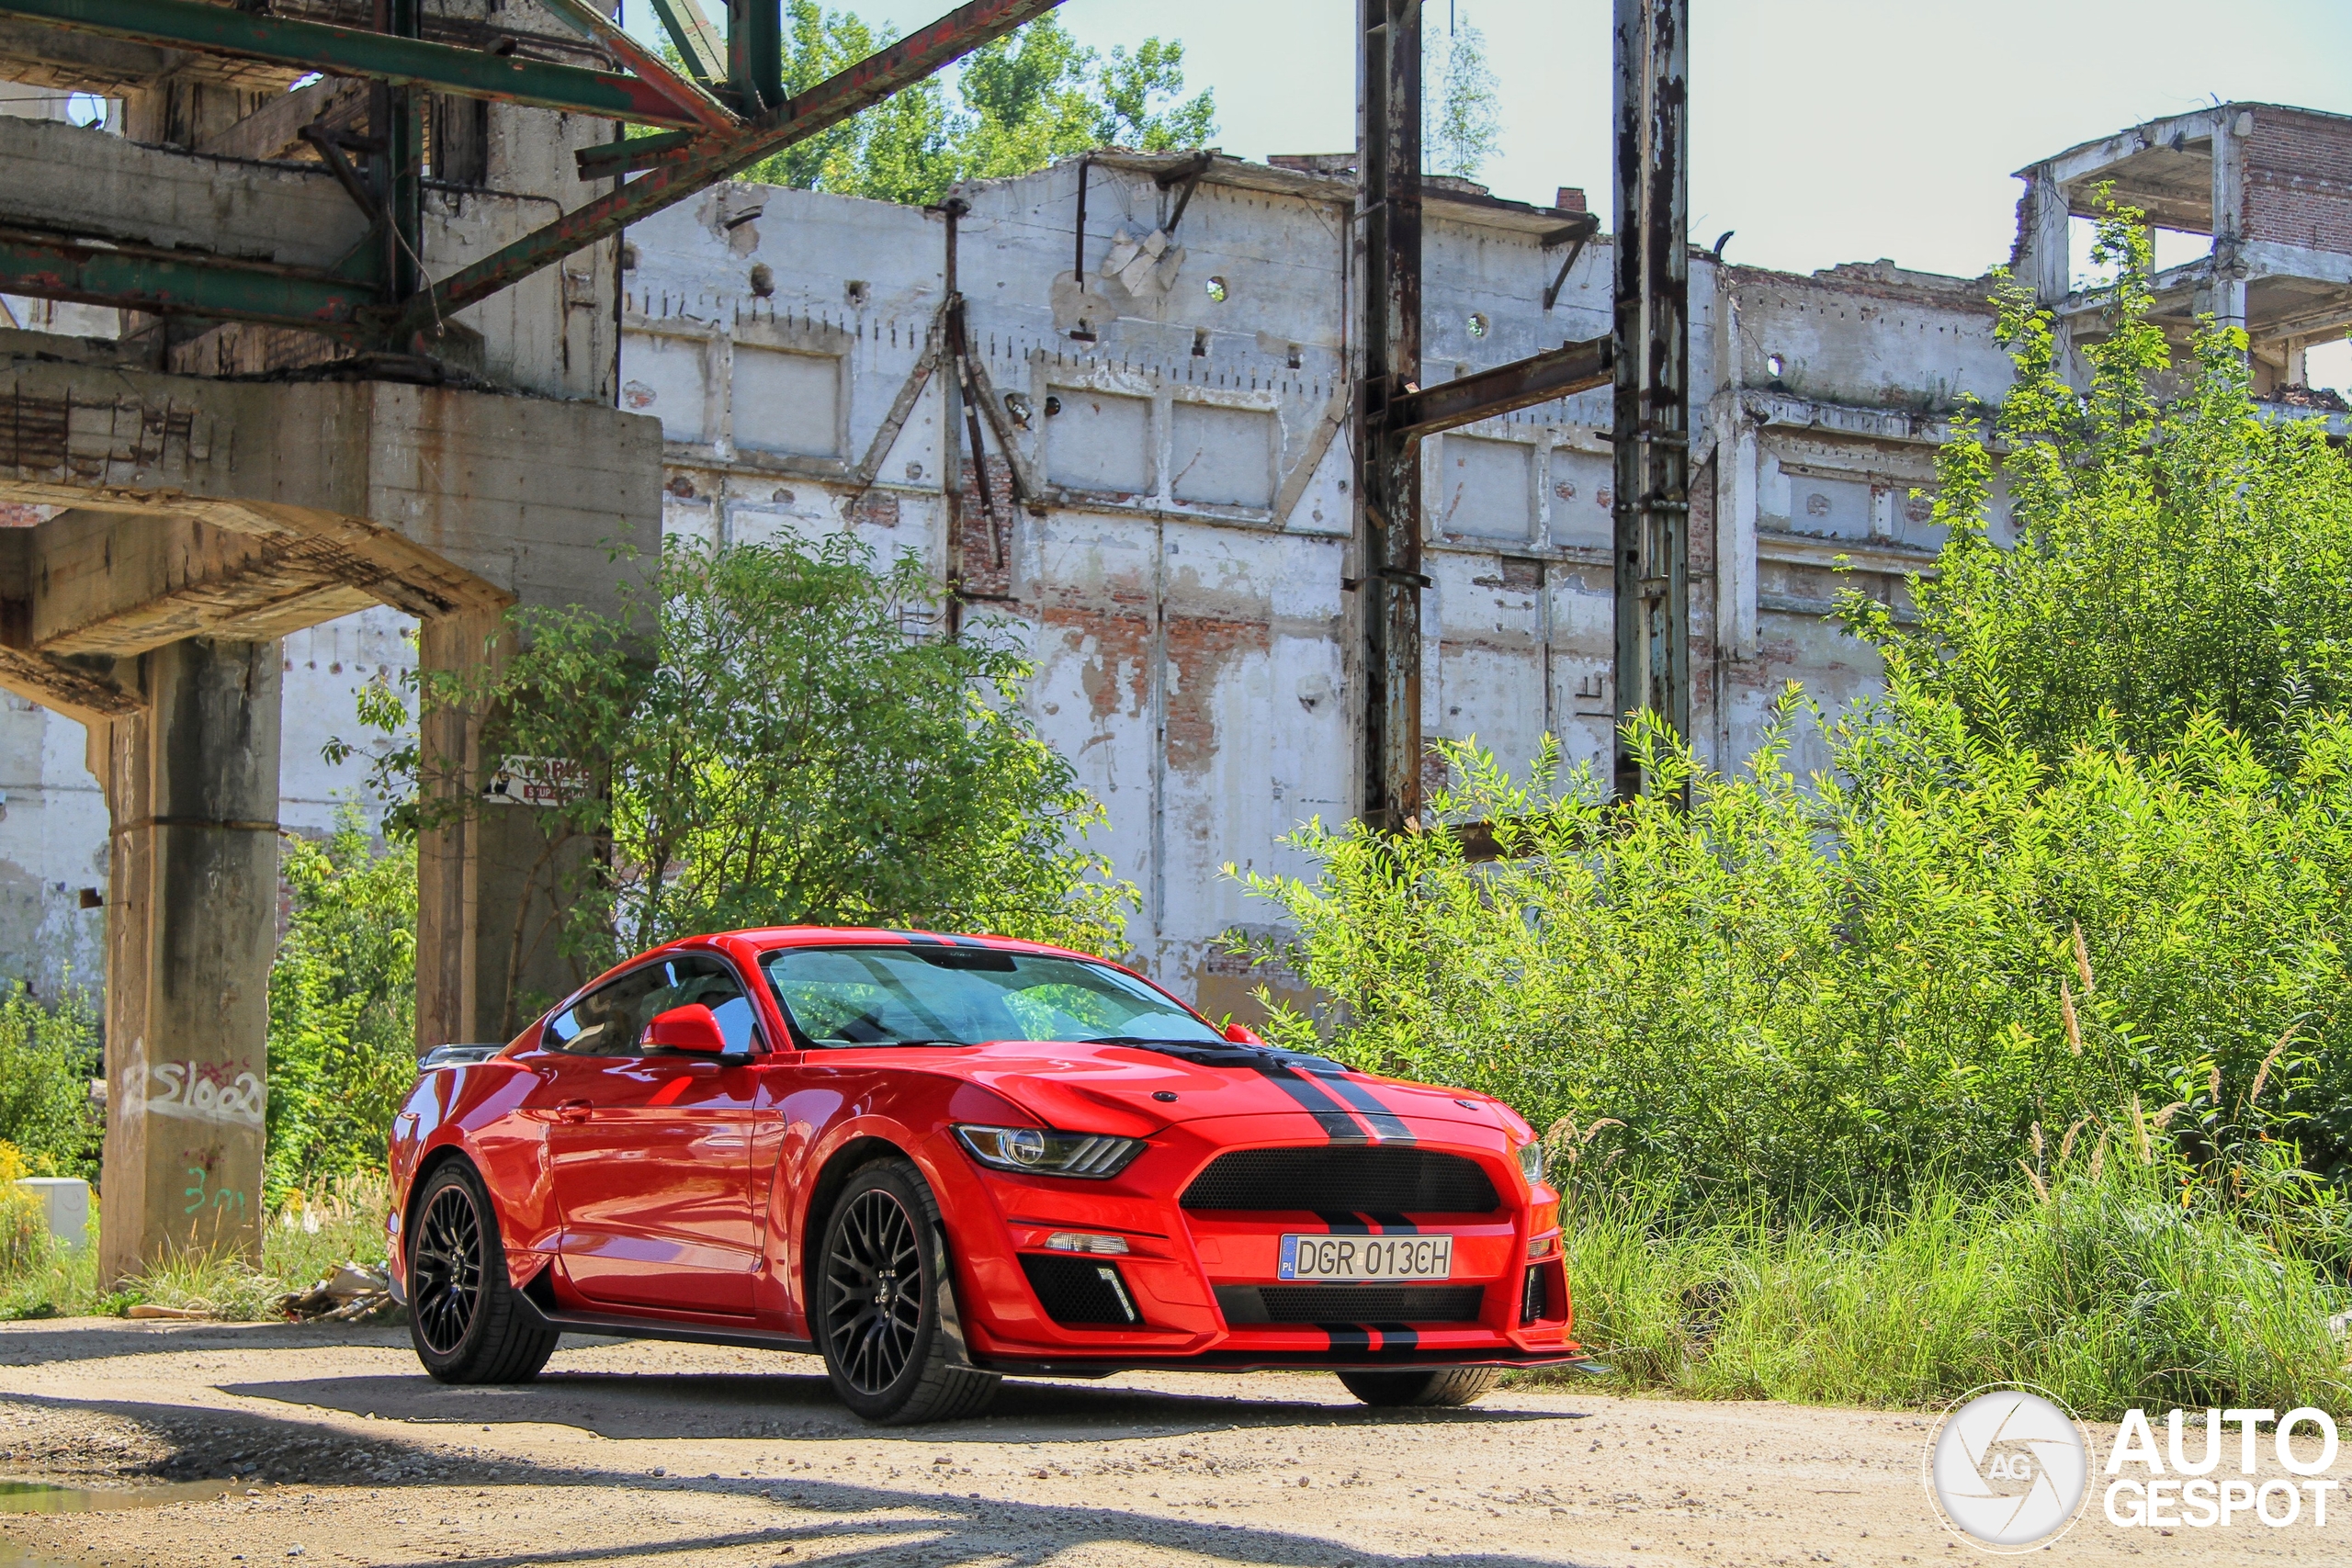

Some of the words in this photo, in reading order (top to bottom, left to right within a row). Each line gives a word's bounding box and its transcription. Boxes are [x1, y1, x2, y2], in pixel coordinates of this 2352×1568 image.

[1282, 1262, 1294, 1272] PL
[1297, 1240, 1355, 1275] DGR
[1365, 1240, 1449, 1275] 013CH
